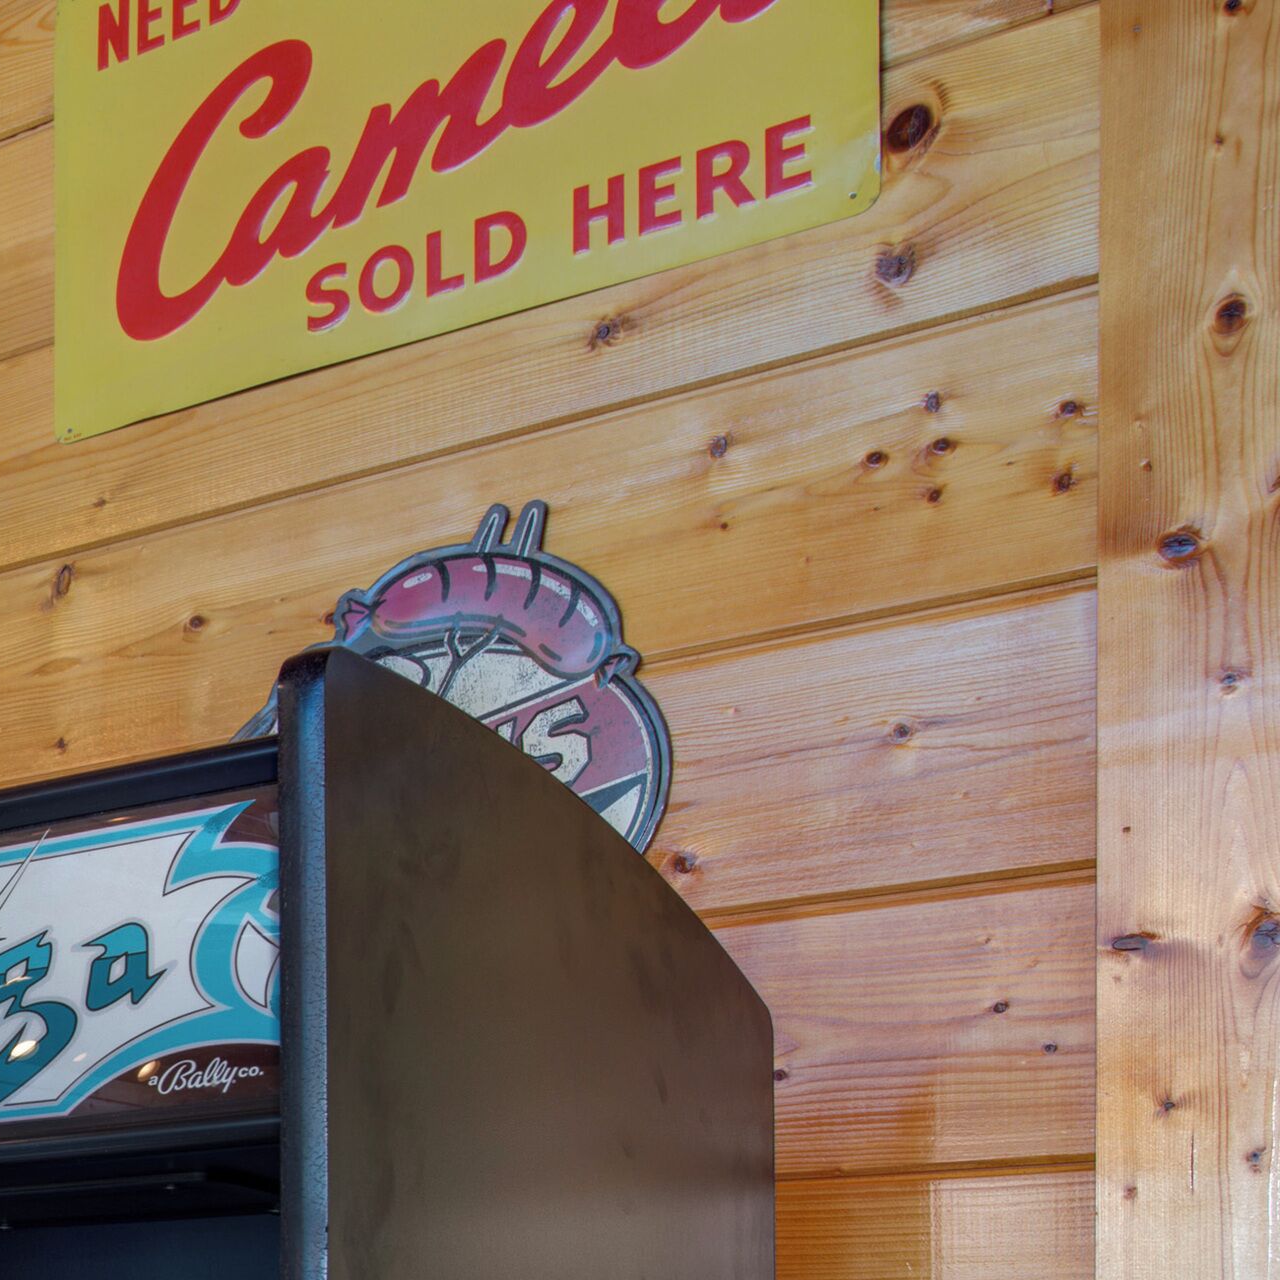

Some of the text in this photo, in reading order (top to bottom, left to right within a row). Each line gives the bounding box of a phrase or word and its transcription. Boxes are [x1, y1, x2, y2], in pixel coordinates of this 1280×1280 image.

[115, 0, 781, 342] Came
[307, 113, 816, 334] SOLD HERE
[148, 1075, 159, 1086] a
[157, 1057, 238, 1095] Bally
